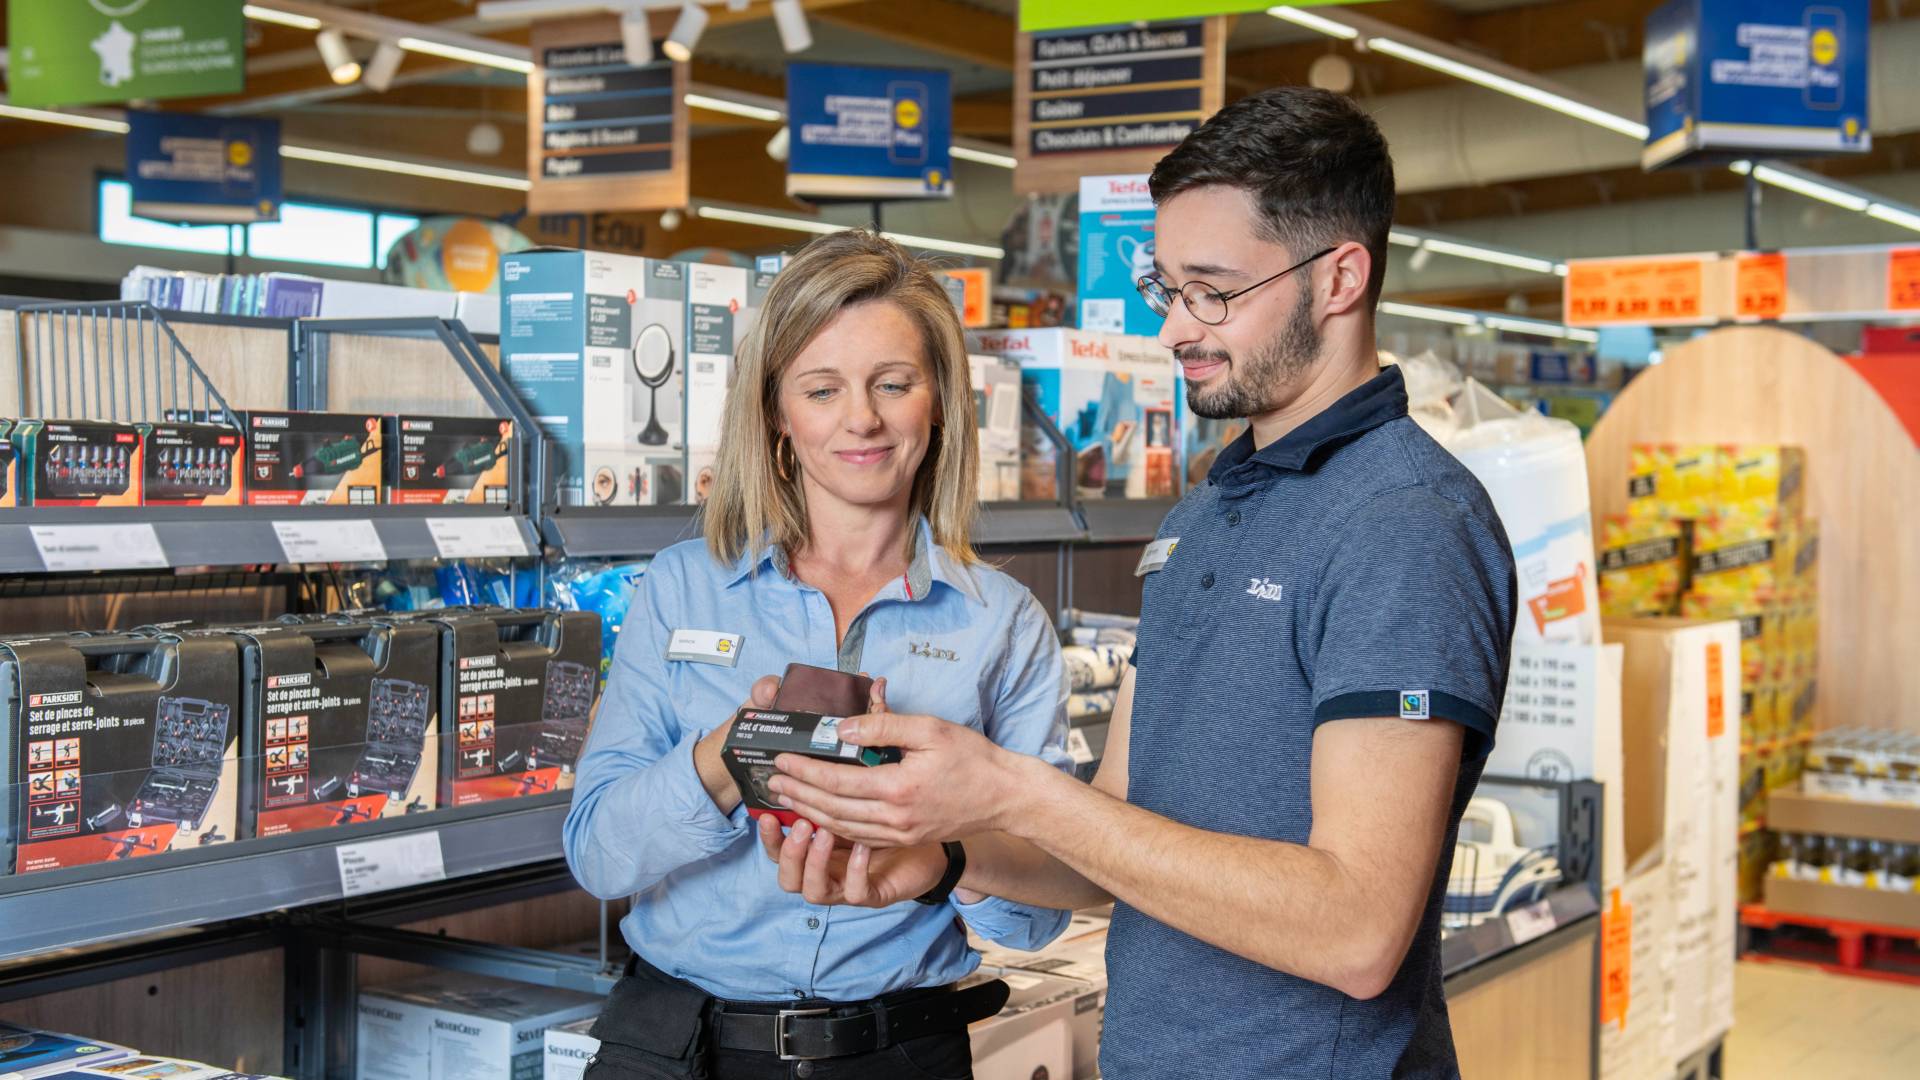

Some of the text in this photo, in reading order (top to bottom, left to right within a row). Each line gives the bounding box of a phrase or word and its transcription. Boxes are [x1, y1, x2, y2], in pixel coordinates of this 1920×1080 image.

[1109, 179, 1151, 194] Tefa
[278, 675, 309, 686] PARKSIDE
[42, 693, 79, 704] PARKSIDE
[267, 686, 320, 702] Set de pinces de
[267, 703, 292, 714] serrage
[294, 701, 301, 711] et
[302, 696, 340, 710] serre-joints
[30, 706, 94, 722] Set de pinces de
[29, 723, 60, 736] serrage
[62, 720, 70, 732] et
[71, 716, 119, 731] serre-joints
[738, 722, 793, 734] Set d'embouts
[516, 1027, 544, 1044] SILVER
